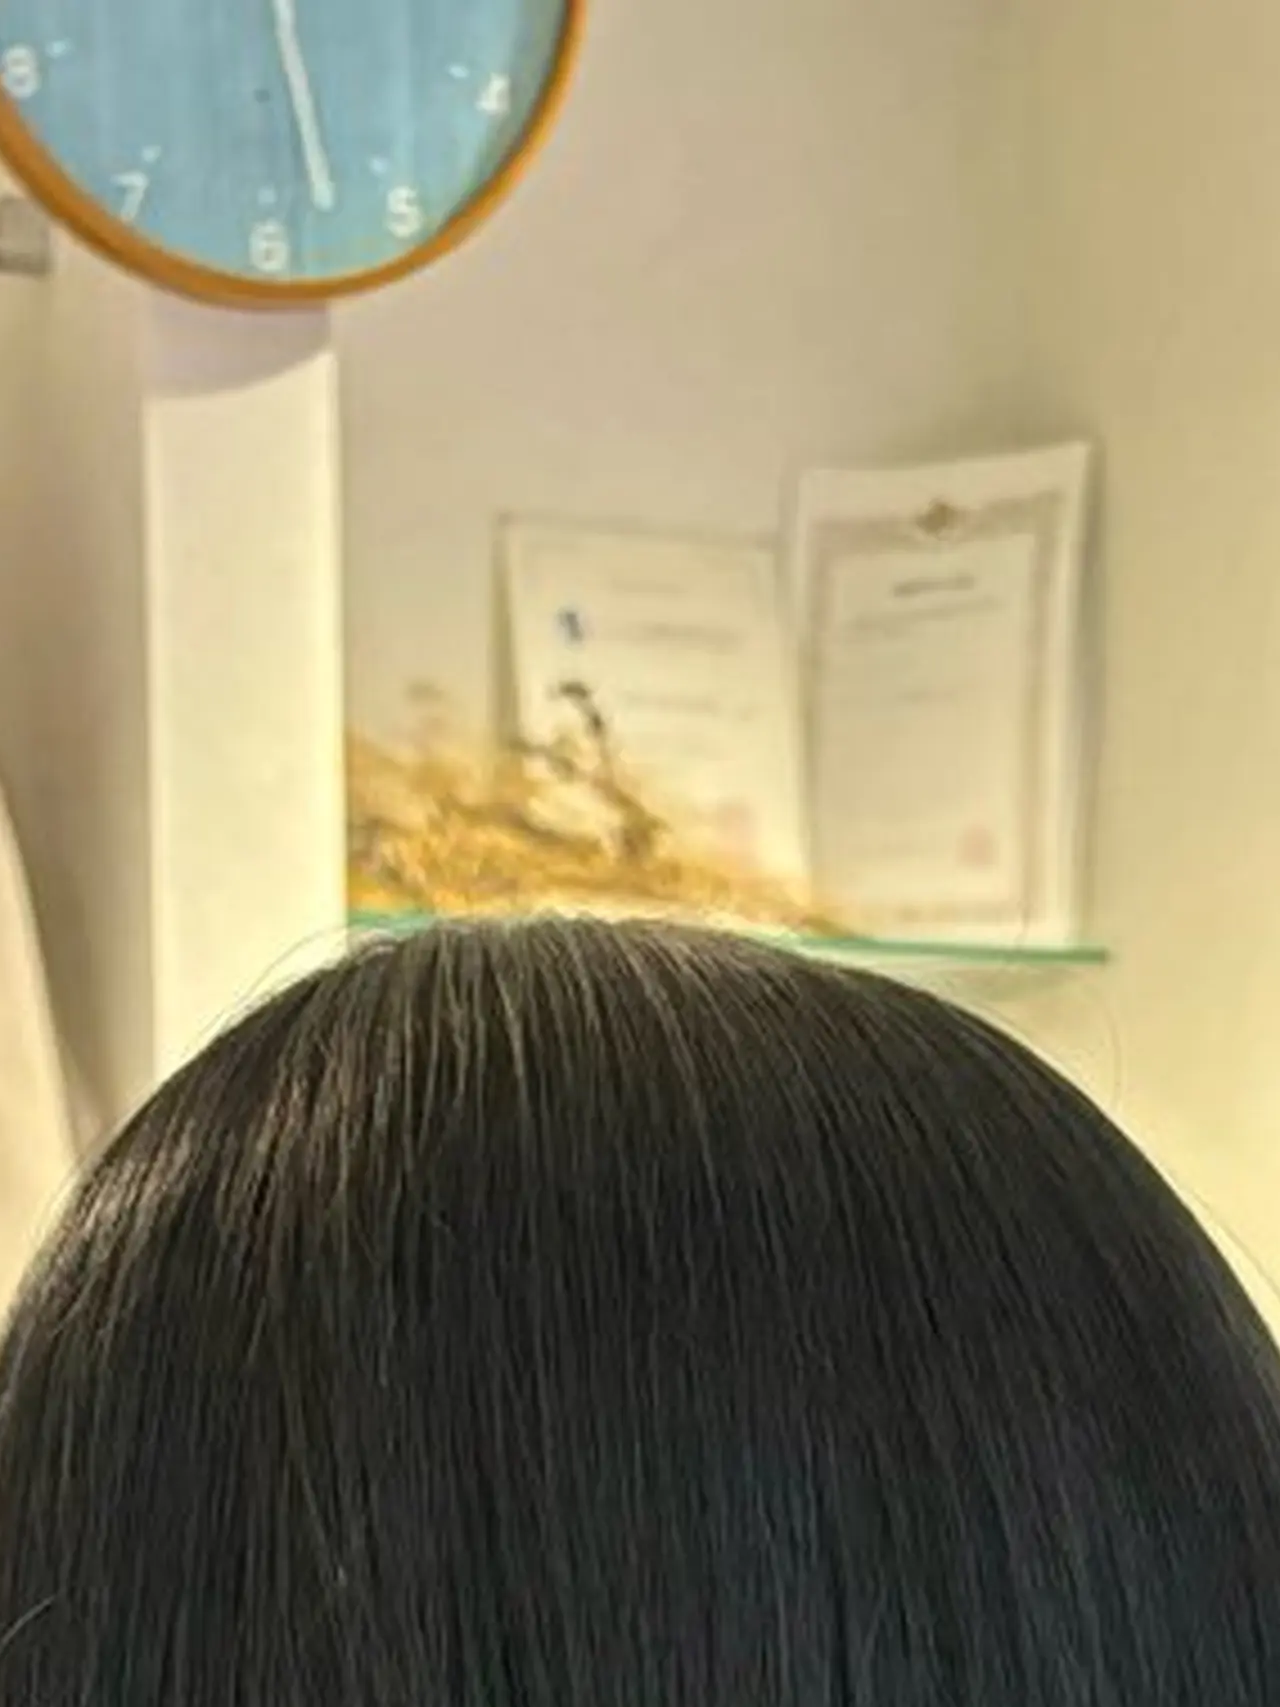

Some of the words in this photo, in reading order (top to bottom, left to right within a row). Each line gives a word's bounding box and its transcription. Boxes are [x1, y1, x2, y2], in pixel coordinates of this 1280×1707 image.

[1, 44, 39, 98] 8
[385, 184, 422, 238] 5
[249, 217, 291, 273] 6
